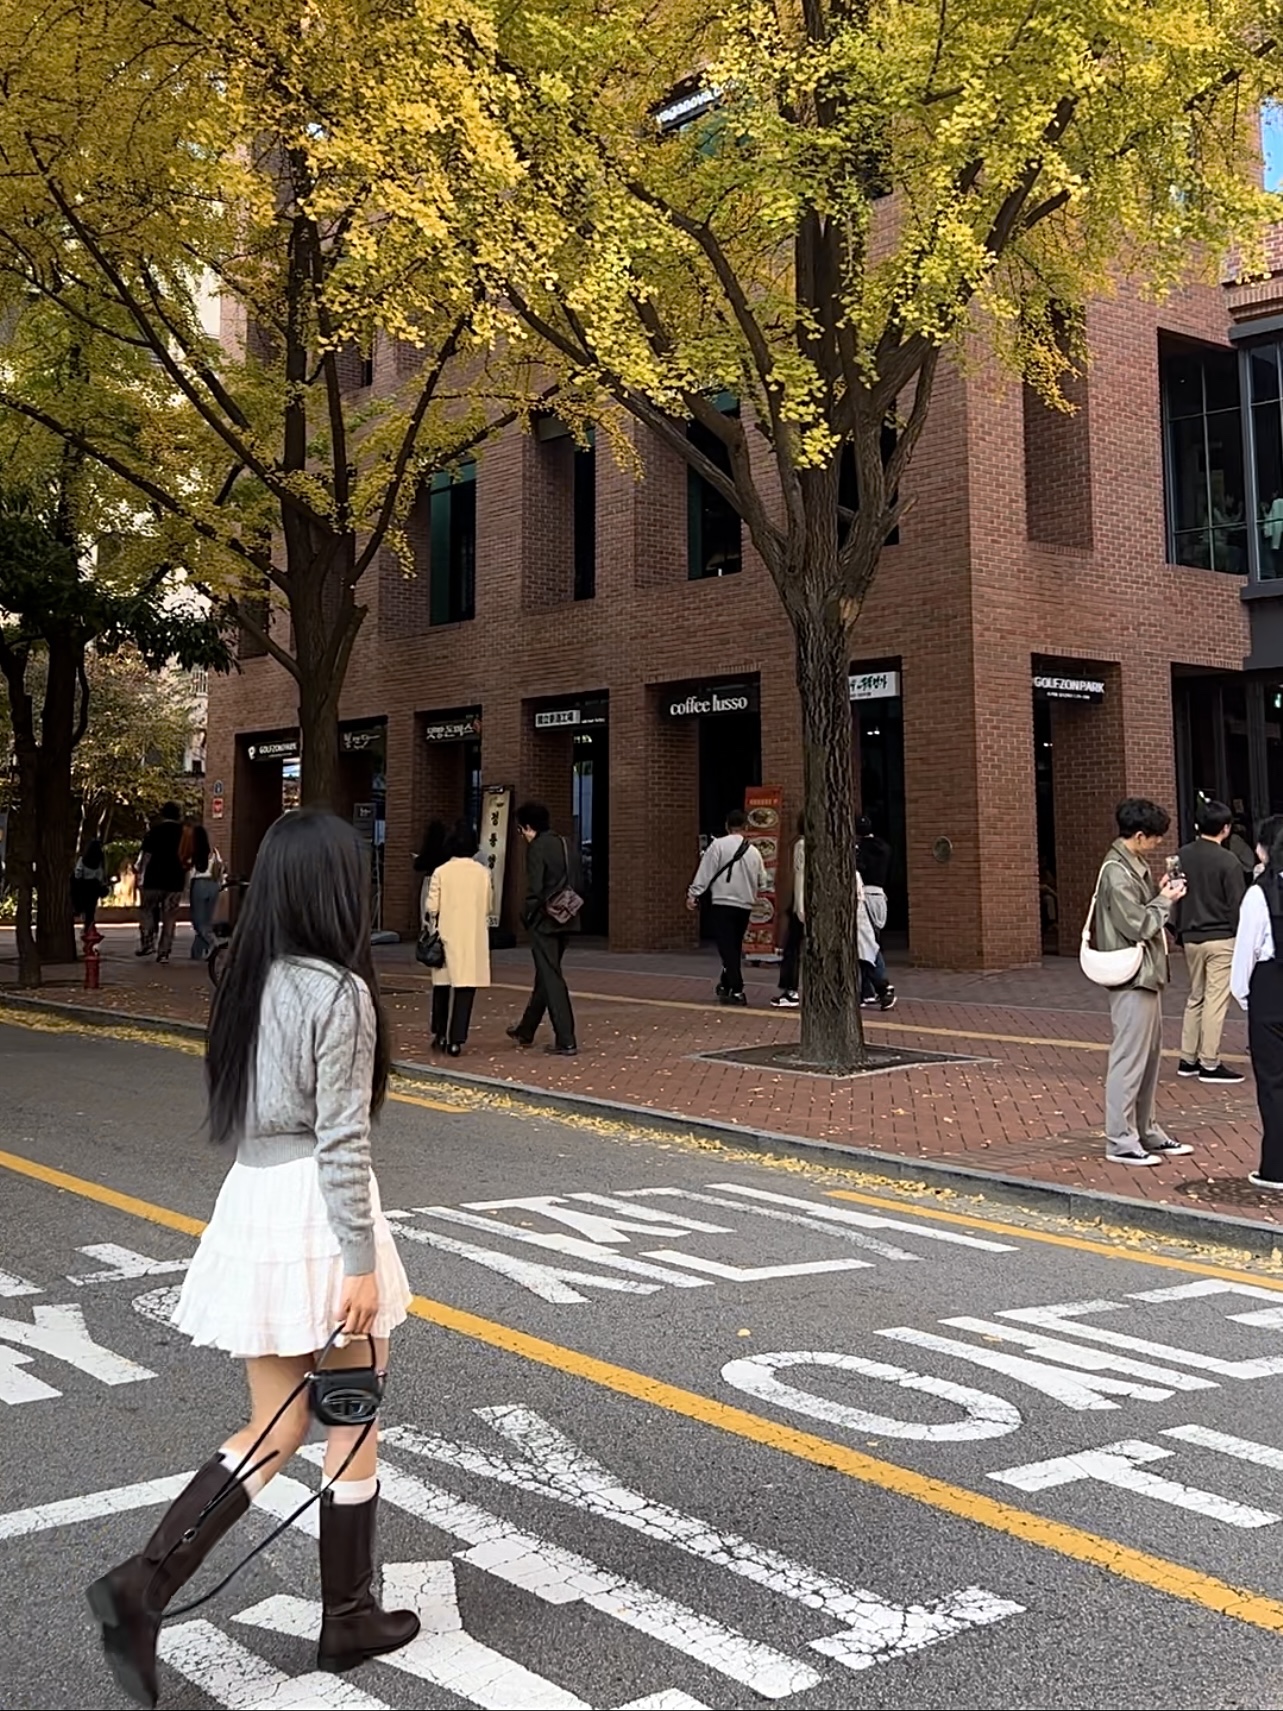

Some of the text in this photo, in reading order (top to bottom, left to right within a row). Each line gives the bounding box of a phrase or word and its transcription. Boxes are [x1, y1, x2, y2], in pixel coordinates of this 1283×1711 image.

[669, 693, 749, 716] coffee lusso
[720, 1278, 1283, 1529] 우선
